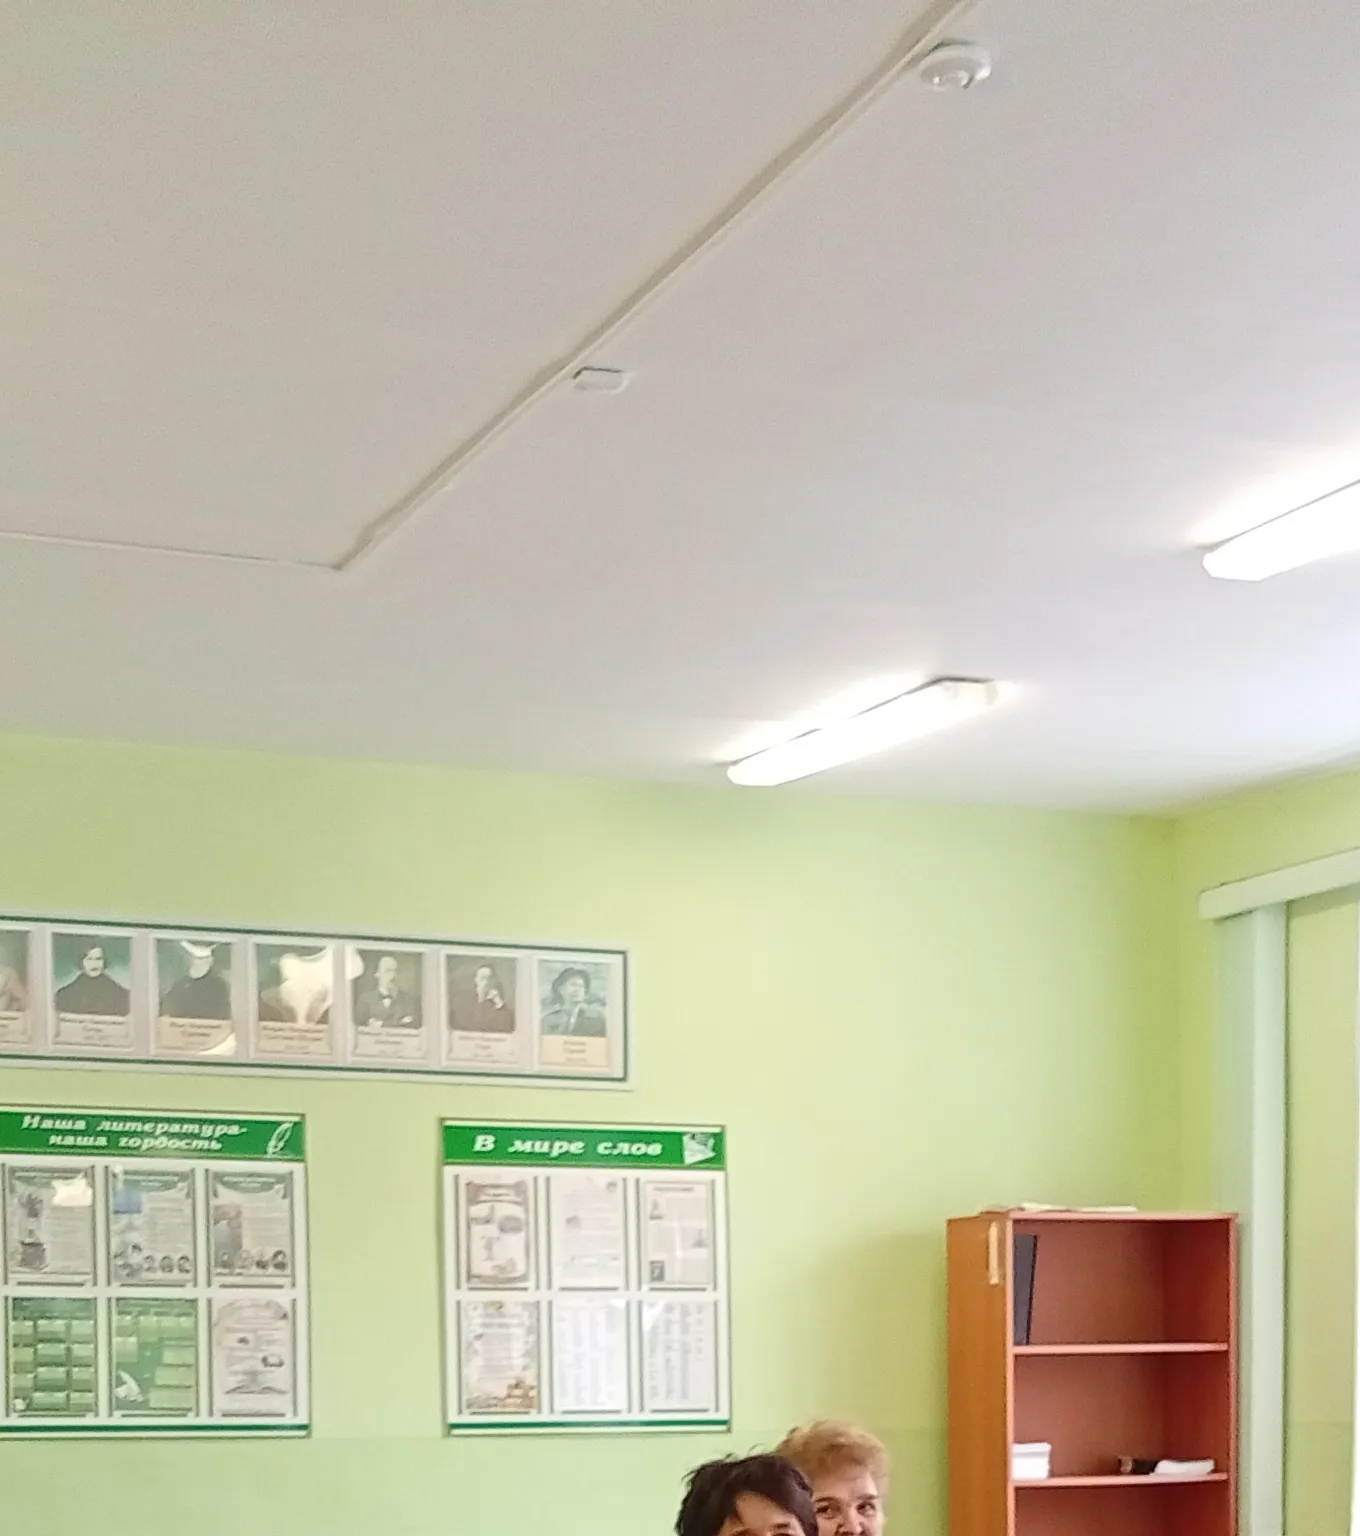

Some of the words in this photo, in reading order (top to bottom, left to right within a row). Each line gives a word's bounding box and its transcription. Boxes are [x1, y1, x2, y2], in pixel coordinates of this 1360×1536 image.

[21, 1115, 87, 1131] Наша
[48, 1134, 109, 1147] наша
[118, 1135, 223, 1153] гордость
[472, 1134, 497, 1152] В
[507, 1139, 586, 1158] мире
[597, 1141, 663, 1156] слов
